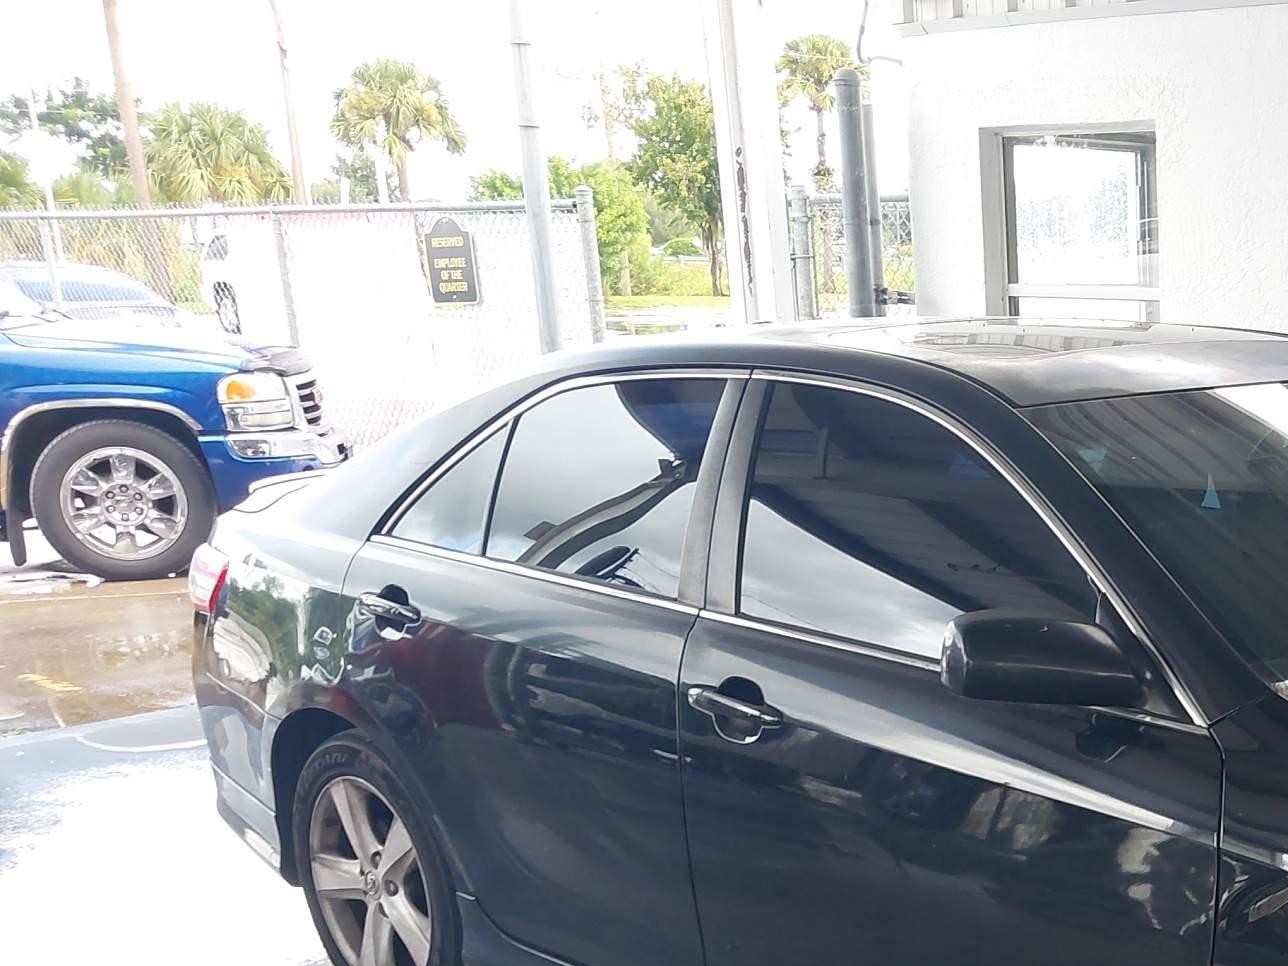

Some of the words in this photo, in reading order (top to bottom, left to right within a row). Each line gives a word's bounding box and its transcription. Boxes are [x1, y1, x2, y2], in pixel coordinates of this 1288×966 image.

[431, 236, 464, 248] RESERVED
[434, 257, 467, 268] EMPLOYEE
[441, 270, 451, 281] OF
[452, 269, 464, 280] THE
[439, 281, 469, 294] QUARTER
